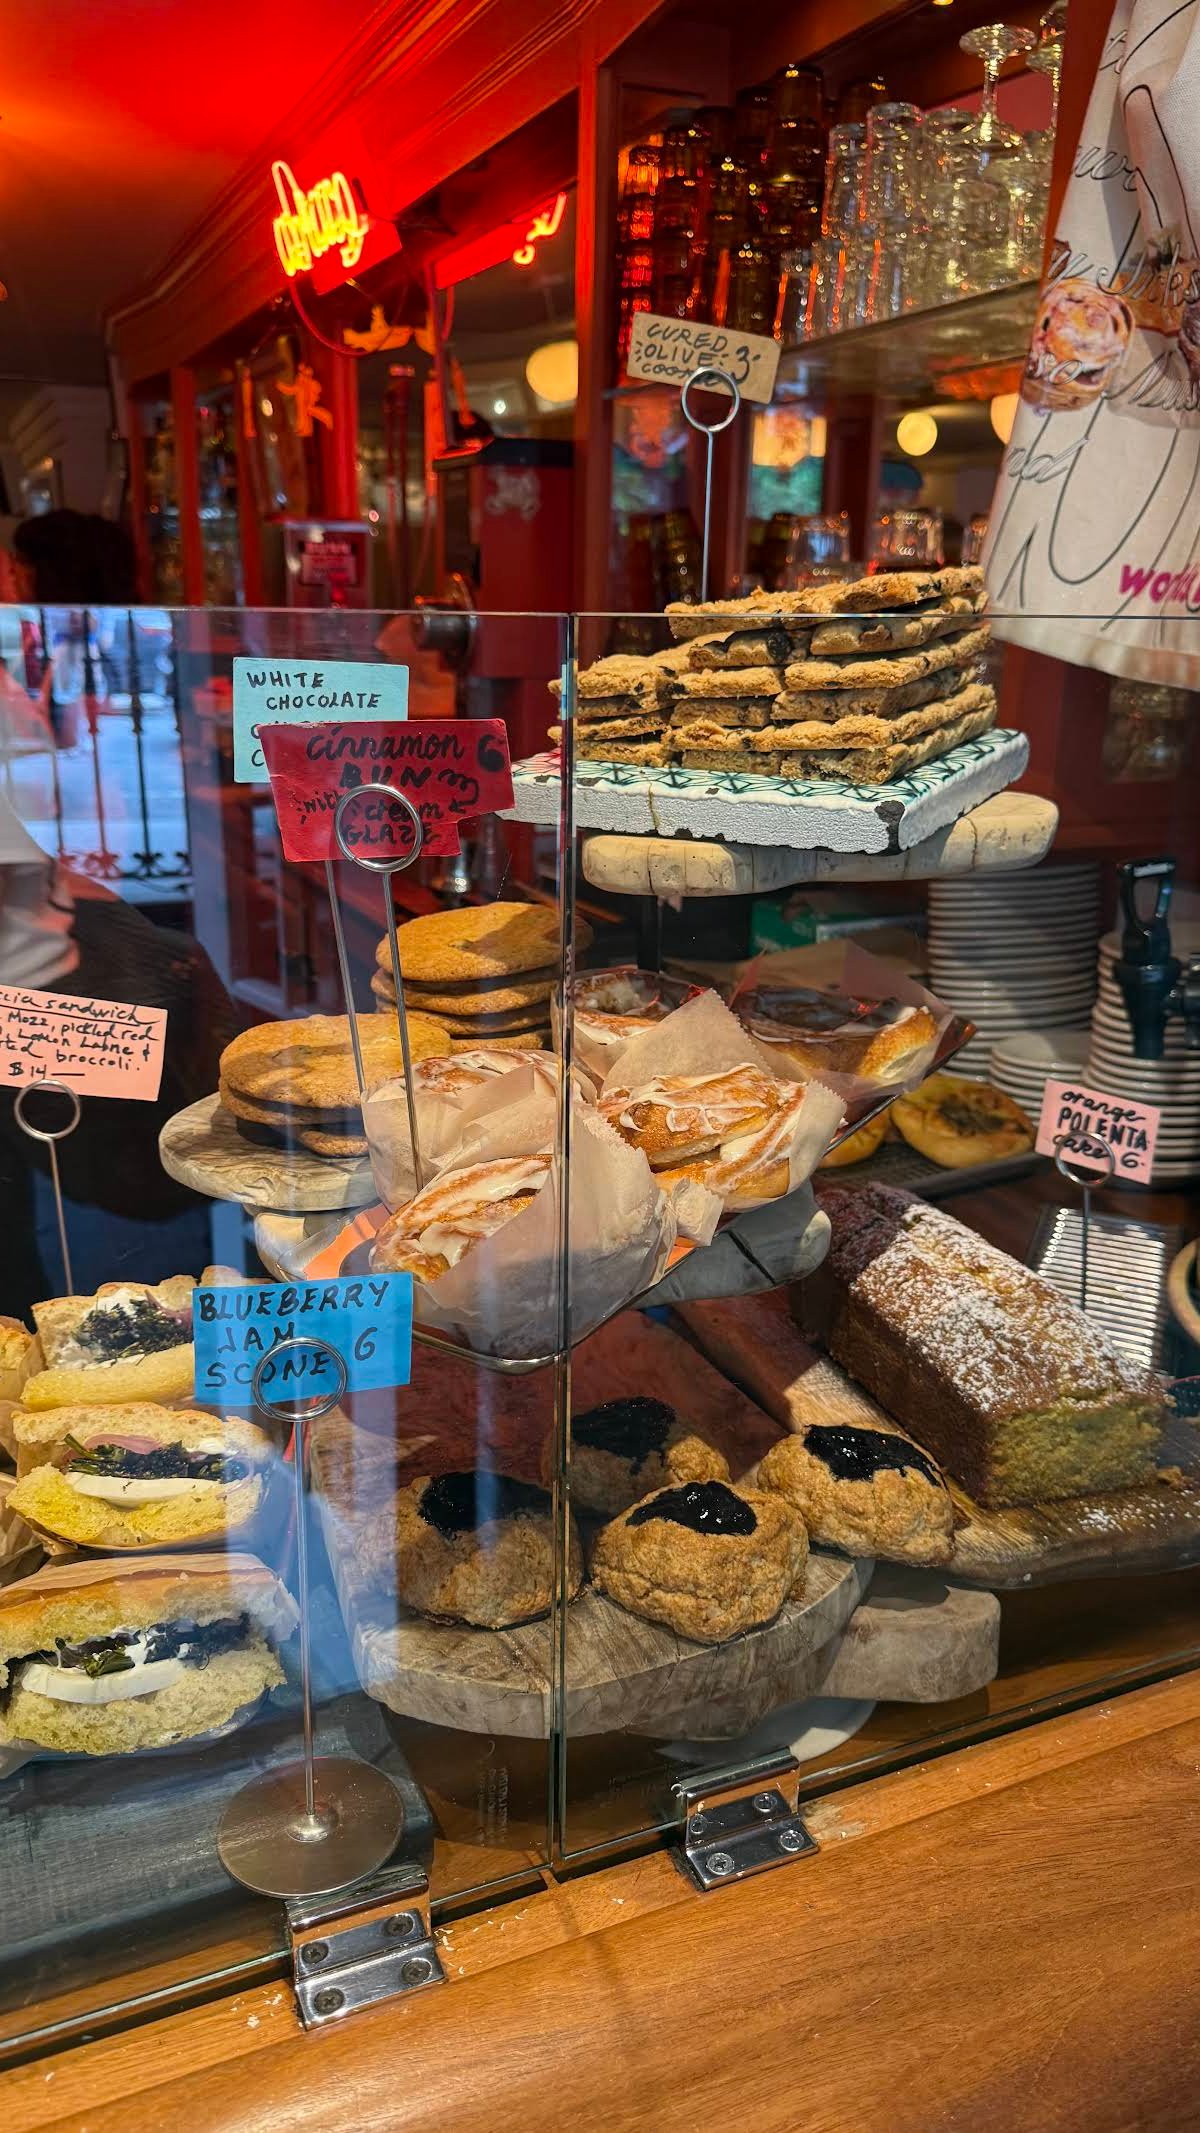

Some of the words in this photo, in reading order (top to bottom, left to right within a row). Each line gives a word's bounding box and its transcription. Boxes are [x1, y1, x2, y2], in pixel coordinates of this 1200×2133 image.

[647, 323, 728, 352] CURED
[644, 343, 716, 367] OLIVE
[246, 671, 325, 689] WHITE
[266, 691, 382, 710] CHOCOLATE
[476, 734, 506, 772] 6
[339, 762, 433, 789] BUN
[0, 991, 43, 1008] cia
[45, 999, 160, 1025] sandwich
[61, 1021, 117, 1039] pickled
[121, 1026, 160, 1041] red
[56, 1049, 140, 1071] broccoli.
[1061, 1091, 1147, 1122] orange
[1057, 1107, 1148, 1151] POLENTA
[199, 1281, 390, 1322] BLUEBERRY
[217, 1322, 295, 1353] JAM
[354, 1327, 378, 1361] 6
[205, 1351, 331, 1387] SCONE
